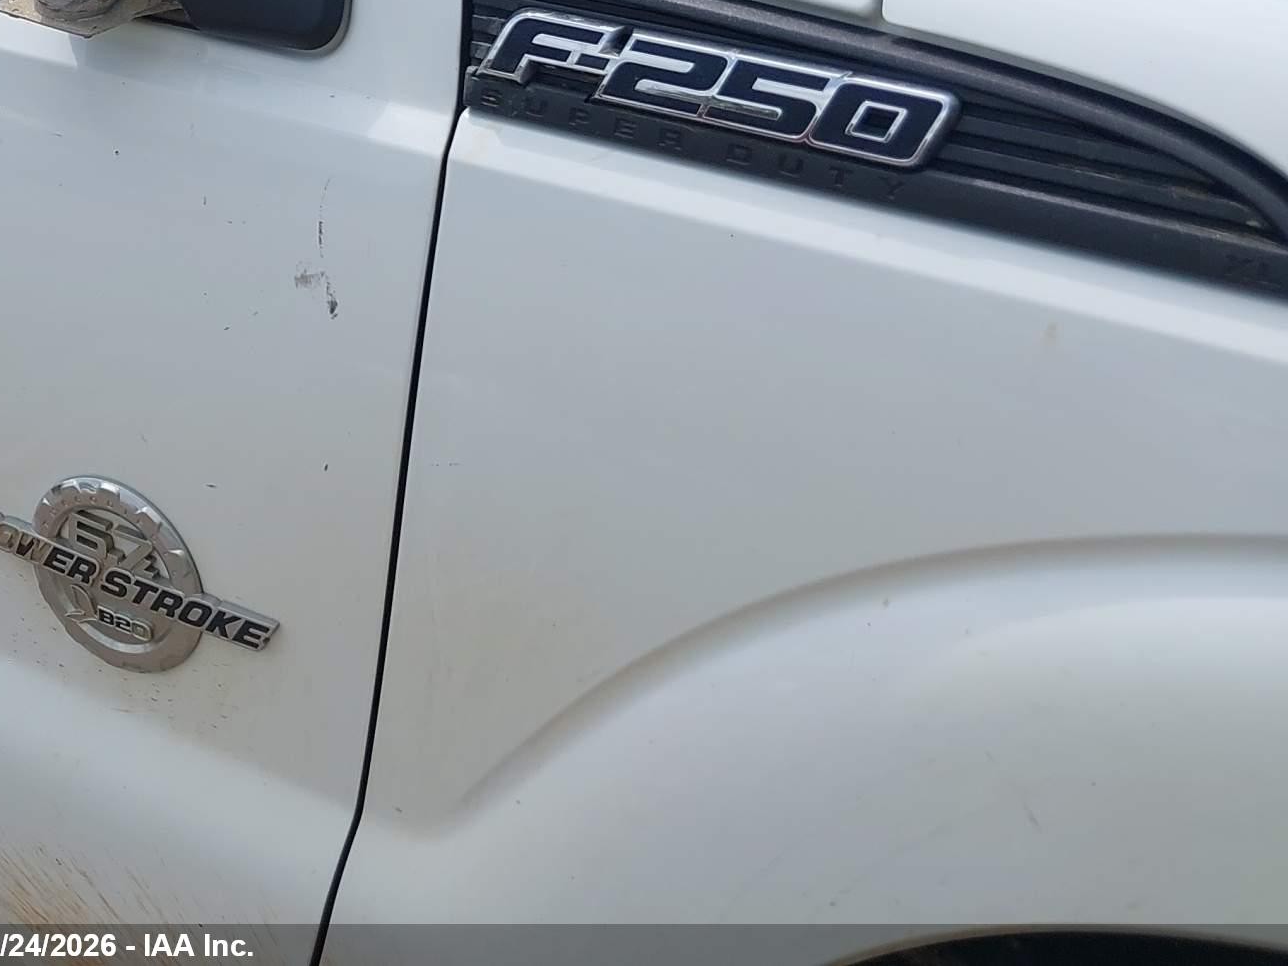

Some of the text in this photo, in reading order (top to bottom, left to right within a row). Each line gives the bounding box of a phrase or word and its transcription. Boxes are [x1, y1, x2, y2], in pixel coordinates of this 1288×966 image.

[478, 10, 955, 166] F-250
[478, 89, 908, 203] SUPER DUTY
[98, 606, 153, 641] B20
[100, 568, 272, 650] STROKE
